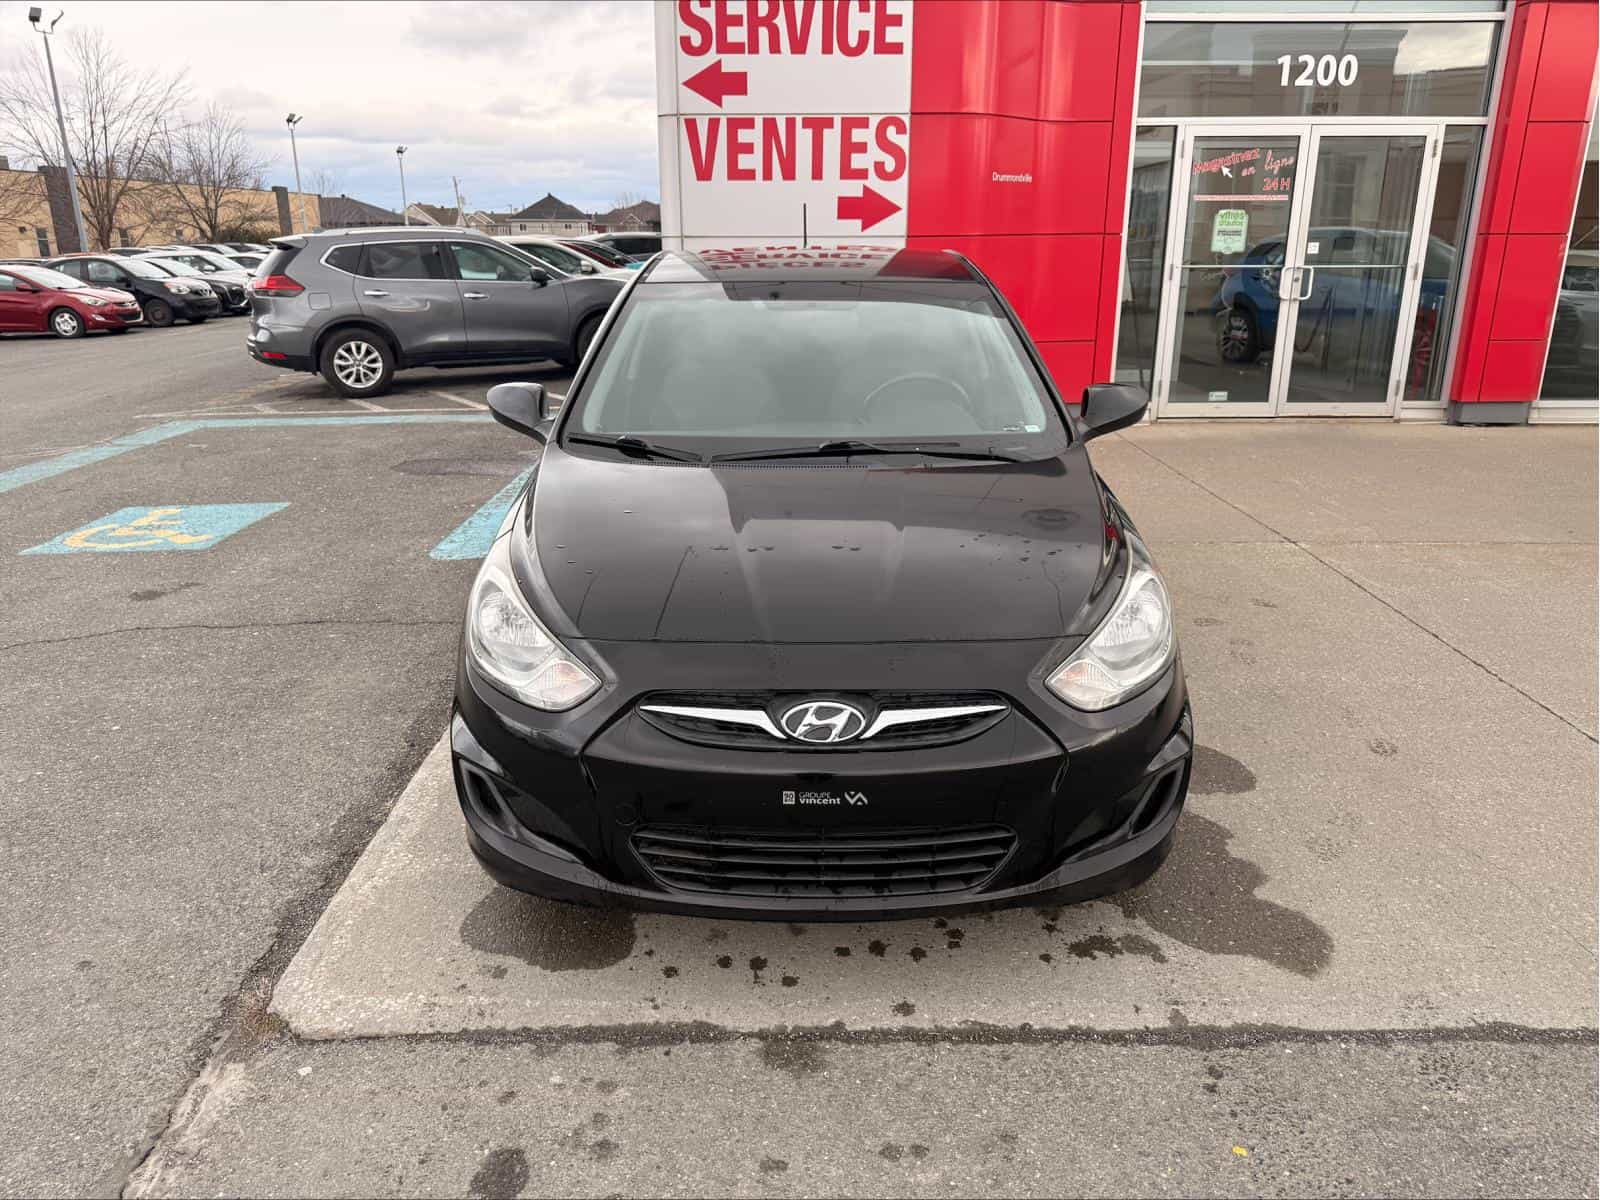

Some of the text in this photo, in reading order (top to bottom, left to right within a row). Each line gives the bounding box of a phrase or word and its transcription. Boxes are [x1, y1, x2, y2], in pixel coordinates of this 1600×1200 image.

[679, 0, 904, 57] SERVICE
[1277, 54, 1359, 87] 1200
[684, 116, 908, 182] VENTES
